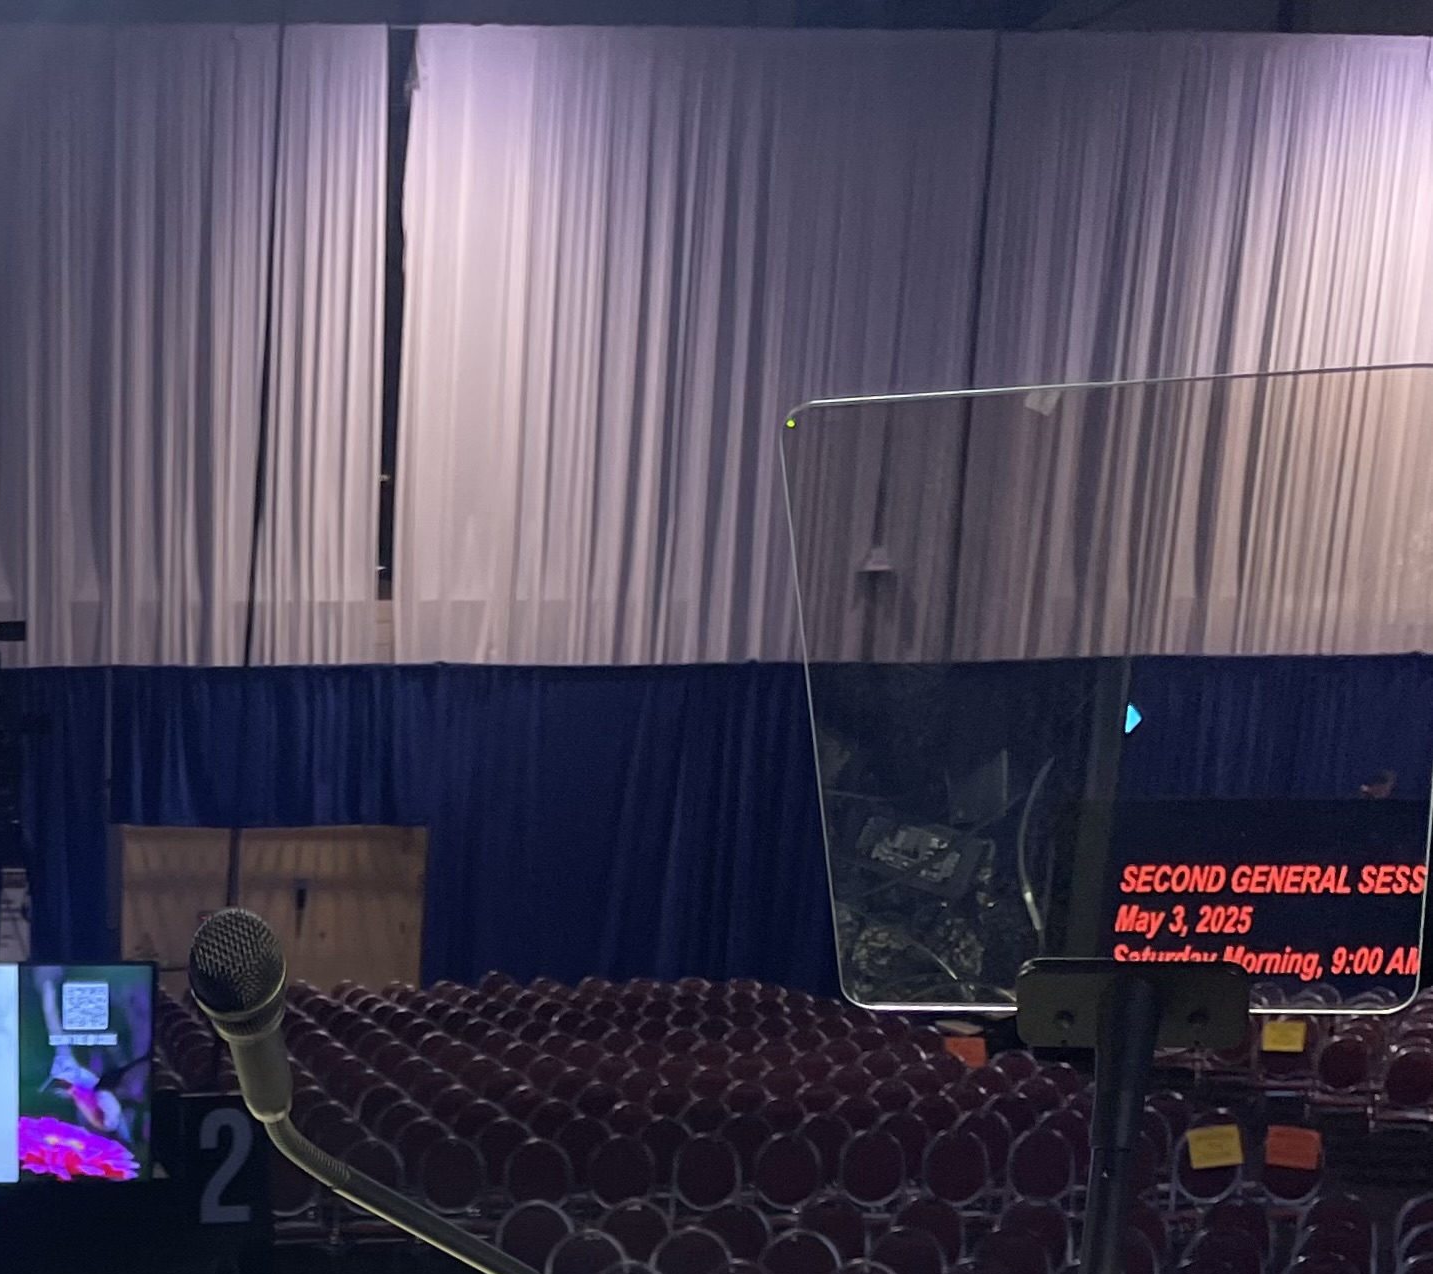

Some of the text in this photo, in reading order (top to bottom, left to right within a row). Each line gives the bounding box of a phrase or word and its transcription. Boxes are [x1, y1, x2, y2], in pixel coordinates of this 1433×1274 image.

[1120, 865, 1225, 893] SECOND
[1231, 865, 1351, 894] GENERAL
[1114, 904, 1254, 939] May 3, 2025
[1223, 945, 1323, 981] Morning,
[1331, 946, 1384, 975] 9:00
[200, 1108, 254, 1224] 2
